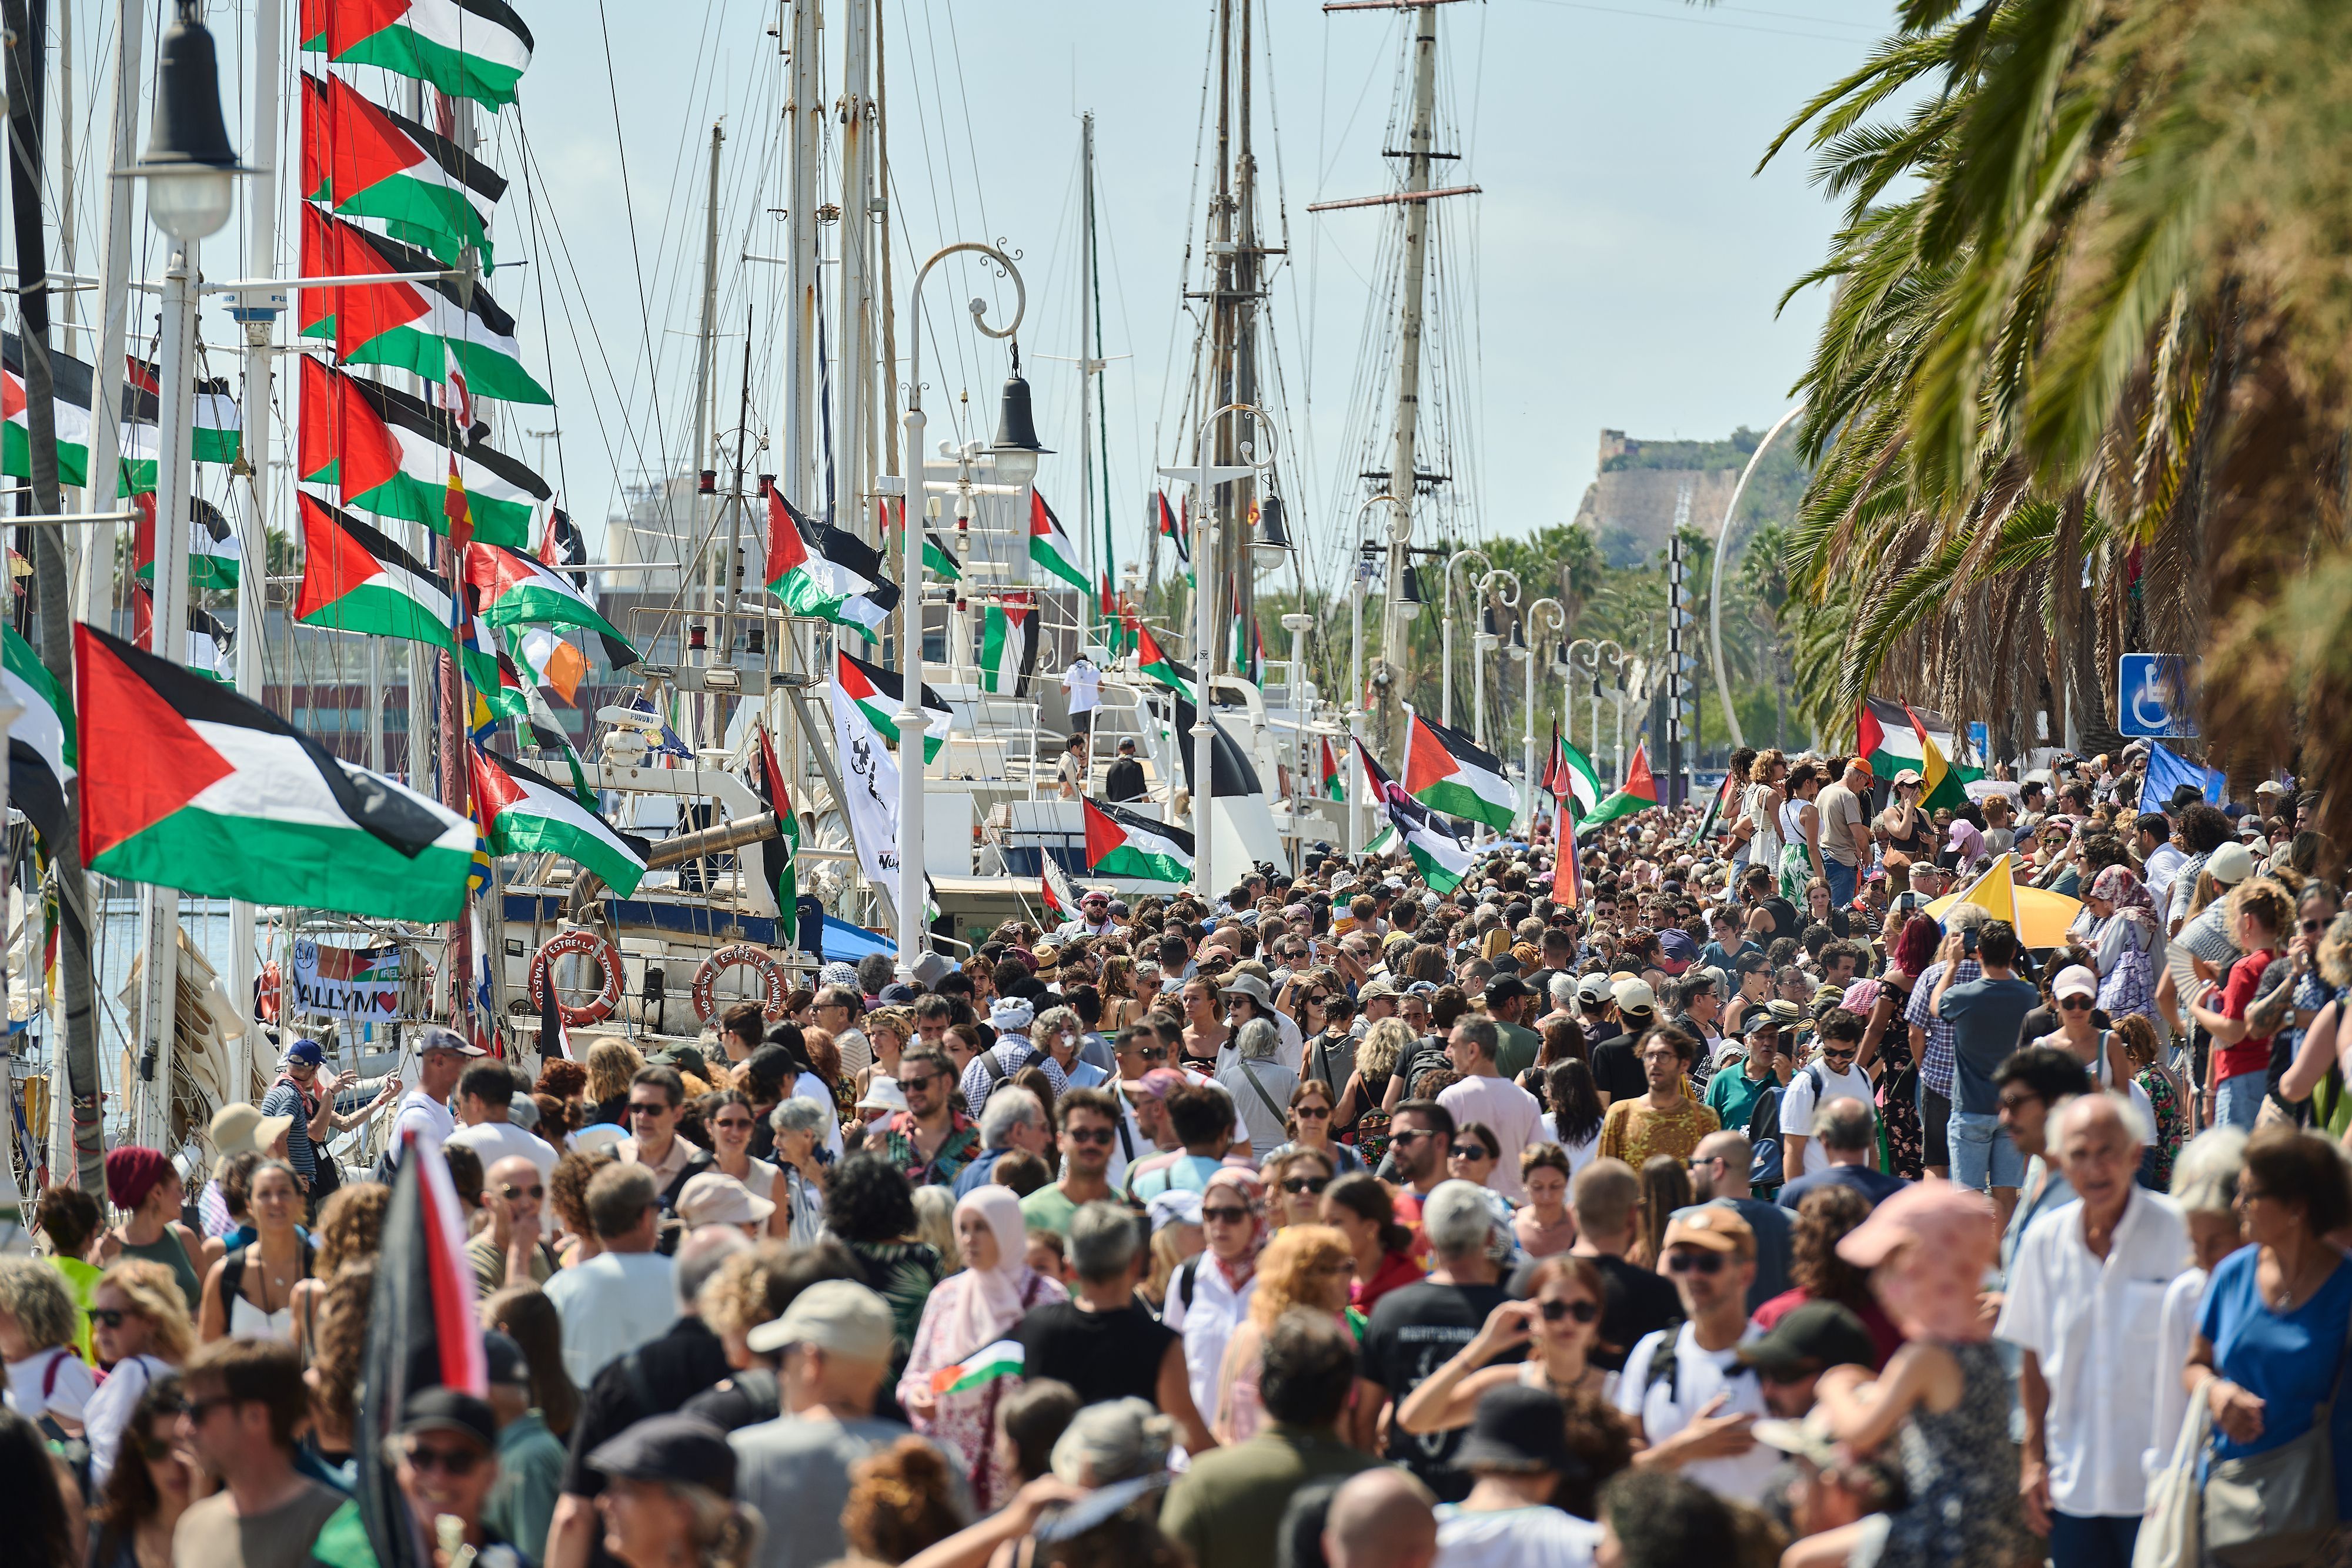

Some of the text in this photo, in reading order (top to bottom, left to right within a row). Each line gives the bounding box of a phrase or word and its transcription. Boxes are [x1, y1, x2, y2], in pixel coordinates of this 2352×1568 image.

[630, 713, 654, 724] FURUNO
[375, 947, 400, 958] PALE
[548, 939, 594, 954] ESTRELLA
[720, 950, 766, 969] ESTRELLA
[380, 969, 399, 978] IREL
[534, 962, 544, 1005] MA5-0
[299, 983, 378, 1012] ALLYM
